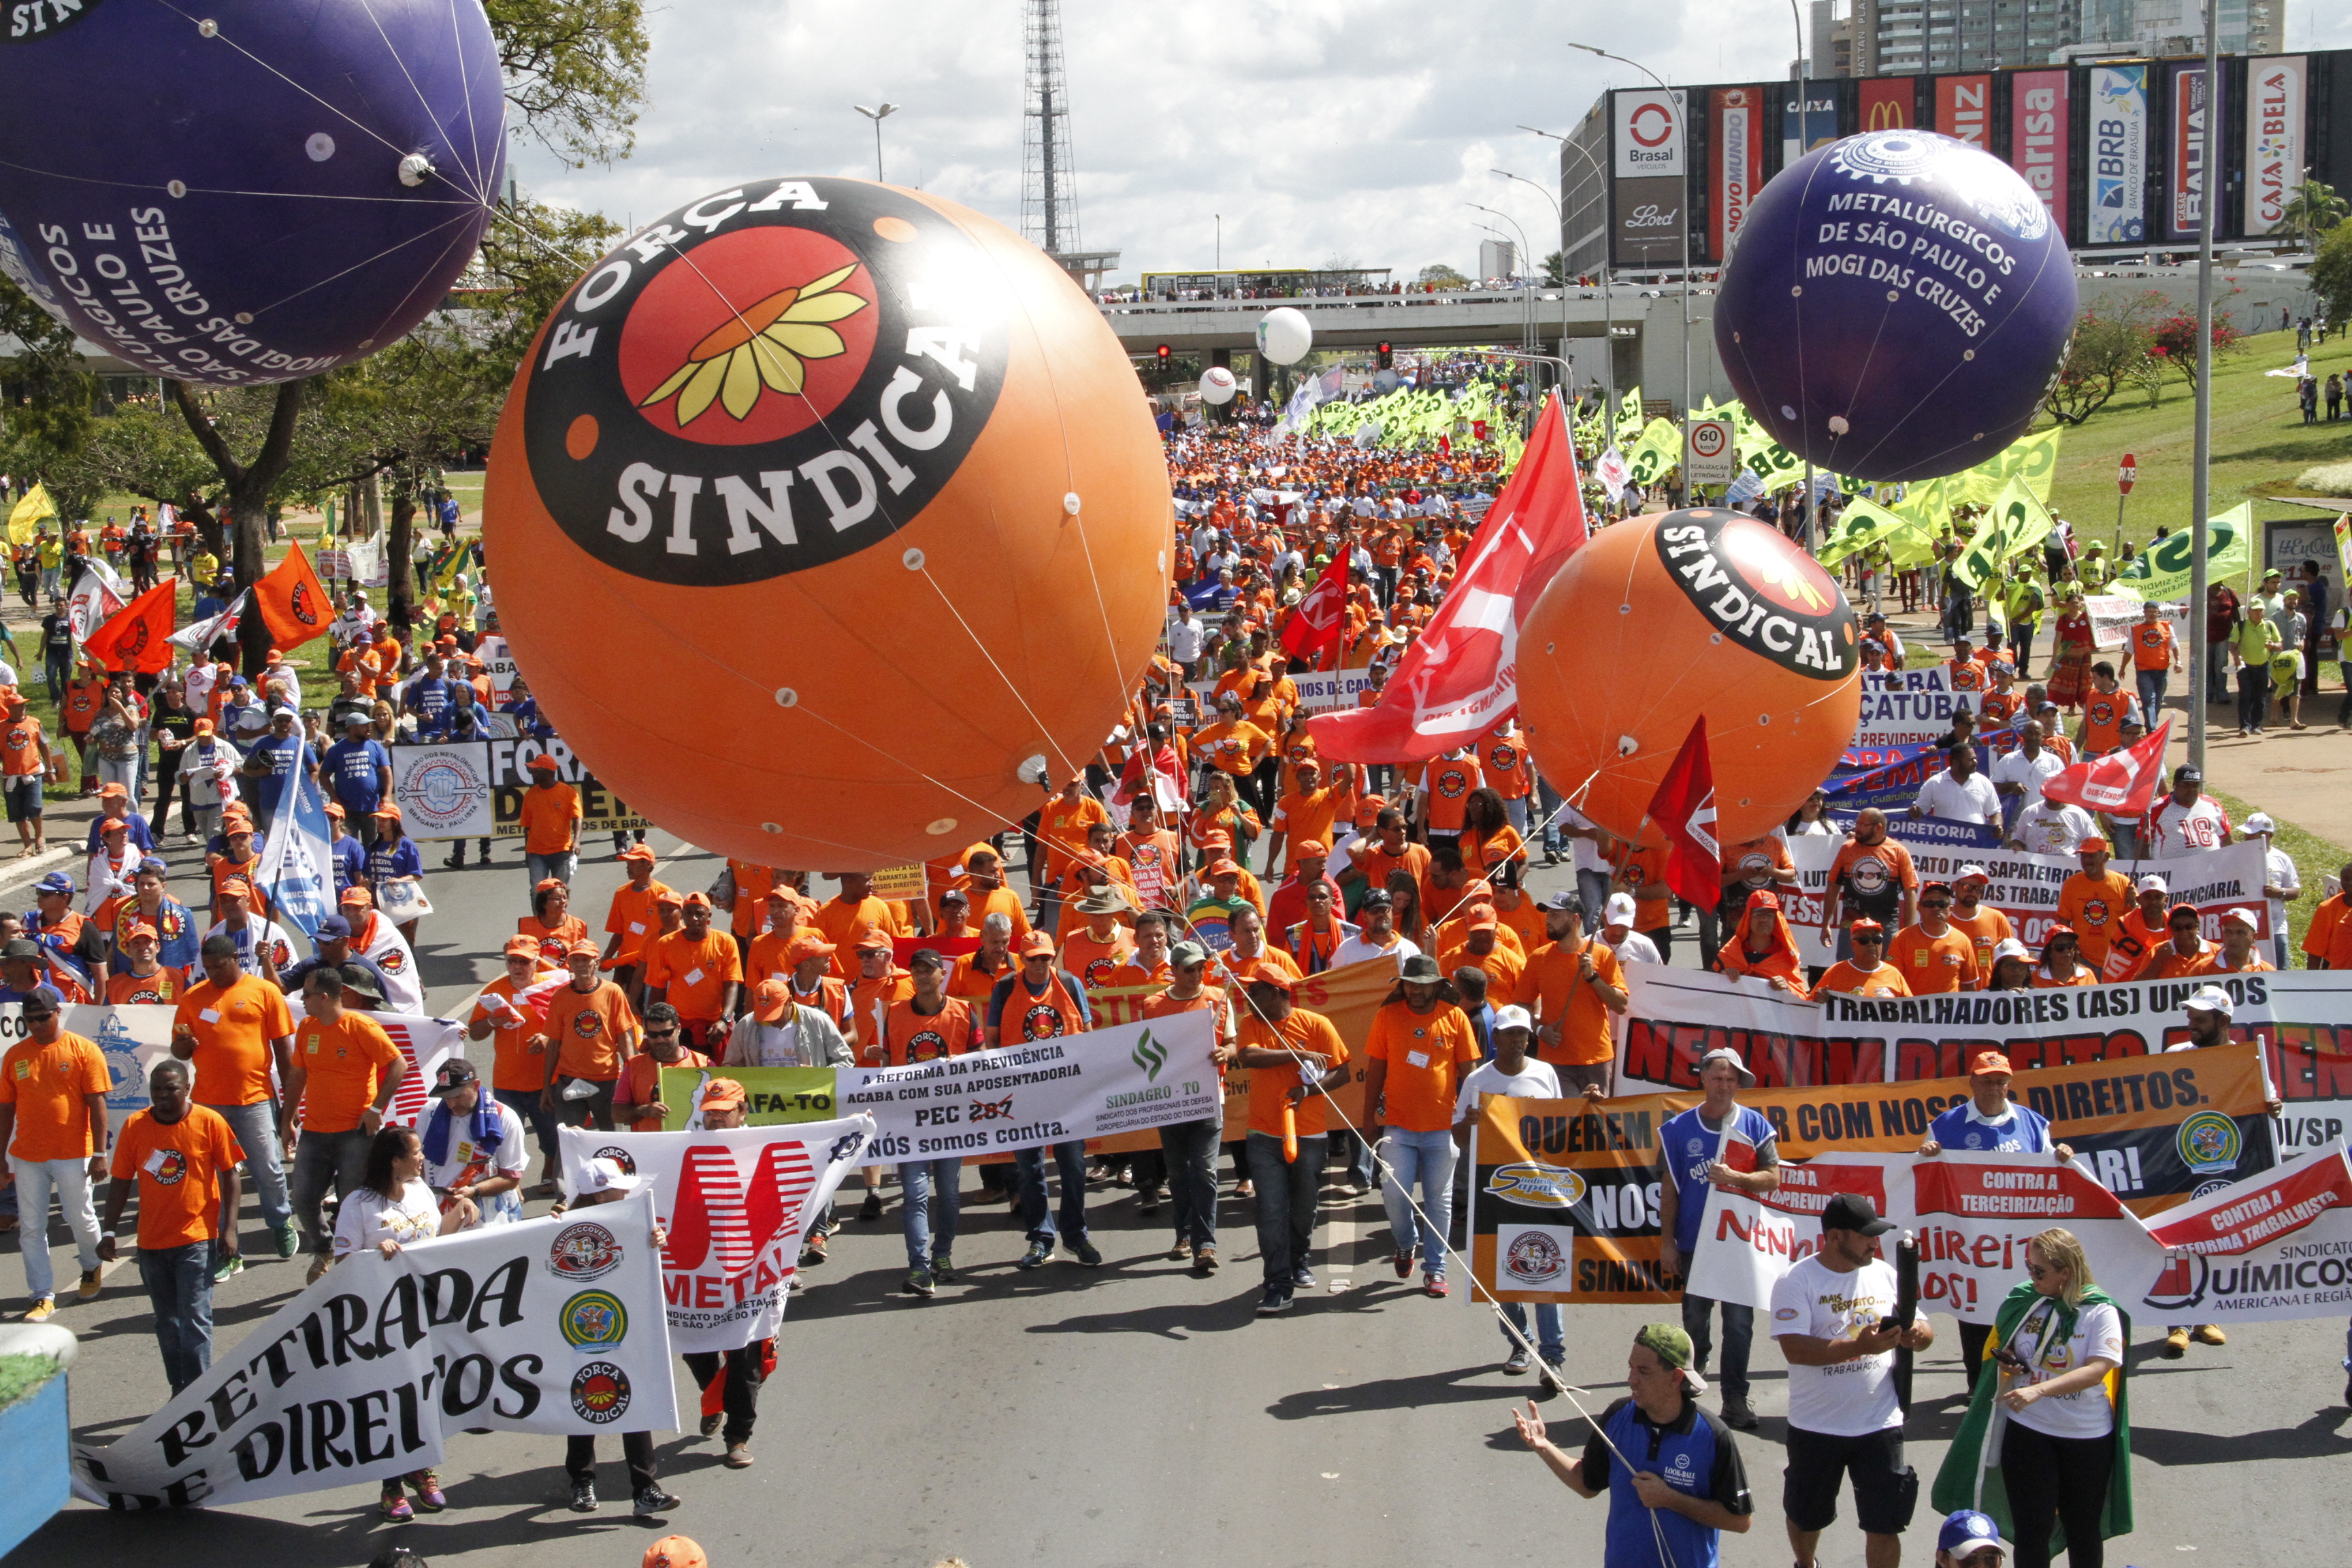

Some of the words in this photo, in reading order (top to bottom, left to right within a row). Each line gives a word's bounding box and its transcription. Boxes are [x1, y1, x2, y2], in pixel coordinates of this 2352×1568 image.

[1786, 99, 1833, 113] CAIXA
[2264, 72, 2285, 135] BELA
[2097, 119, 2125, 176] BRB
[2129, 121, 2139, 160] BRASÍLIA
[1630, 148, 1673, 162] Brasal
[2129, 163, 2138, 175] DE
[2129, 177, 2139, 209] BANCO
[2261, 161, 2283, 221] CASA
[1625, 205, 1678, 227] Lord
[2178, 192, 2187, 221] CASAS
[82, 222, 116, 241] E
[1827, 192, 2016, 276] METALÚRGICOS
[131, 207, 210, 316] CRUZES
[1818, 222, 1849, 243] DE
[1855, 221, 1906, 250] SÃO
[1910, 236, 1986, 290] PAULO
[1984, 284, 2002, 306] E
[543, 181, 830, 372] FORÇA
[95, 253, 188, 345] PAULO
[1806, 254, 1863, 278] MOGI
[1869, 258, 1915, 289] DAS
[1915, 276, 1987, 338] CRUZES
[195, 316, 263, 357] DAS
[250, 348, 342, 372] MOGI
[606, 282, 984, 556] SINDICA
[1699, 430, 1718, 442] 60
[2119, 466, 2136, 482] PARE
[1664, 525, 1842, 671] SINDICAL
[1954, 681, 1975, 691] SINDICAL
[2092, 713, 2113, 727] SINDICAL
[1493, 745, 1514, 754] FORÇA
[403, 757, 424, 786] SINDICATO
[425, 751, 438, 760] DOS
[440, 751, 480, 783] METALÚRGICOS
[1492, 757, 1516, 770] SINDICAL
[1441, 770, 1465, 780] FORÇA
[1439, 783, 1467, 798] SINDICAL
[1856, 798, 1868, 807] de
[1872, 791, 1920, 804] Guarulhos
[408, 808, 444, 830] BRAGANÇA
[449, 805, 478, 828] PAULISTA
[602, 820, 619, 830] DE
[1889, 819, 1977, 840] DIRETORIA
[2178, 817, 2213, 848] 18
[1136, 844, 1157, 852] FORÇA
[1139, 881, 1160, 889] JUROS
[2087, 900, 2106, 909] FORÇA
[2083, 913, 2108, 926] SINDICAL
[538, 937, 564, 952] FORÇA
[1089, 959, 1115, 973] FORÇA
[129, 991, 159, 1002] FORÇA
[1827, 992, 2069, 1026] TRABALHADORES
[2077, 987, 2140, 1019] (AS)
[576, 1010, 600, 1022] FORÇA
[1026, 1005, 1058, 1020] FORÇA
[574, 1023, 602, 1039] SINDICAL
[911, 1031, 942, 1051] FORÇA
[862, 1073, 872, 1085] A
[876, 1066, 945, 1083] REFORMA
[949, 1063, 968, 1075] DA
[972, 1045, 1065, 1073] PREVIDÊNCIA
[847, 1091, 894, 1104] ACABA
[898, 1086, 929, 1100] COM
[934, 1083, 963, 1097] SUA
[966, 1064, 1081, 1093] APOSENTADORIA
[1106, 1085, 1172, 1109] SINDAGRO
[1182, 1081, 1200, 1096] TO
[915, 1105, 960, 1127] PEC
[1095, 1109, 1125, 1122] SINDICATO
[1126, 1108, 1138, 1116] DOS
[1139, 1100, 1181, 1113] PROFISSIONAIS
[1191, 1096, 1213, 1105] DEFESA
[1096, 1119, 1141, 1132] AGROPECUÁRIA
[1150, 1113, 1173, 1123] ESTADO
[1183, 1106, 1214, 1117] TOCANTINS
[1520, 1110, 1653, 1157] QUEREM
[1797, 1101, 1874, 1142] COM
[2027, 1068, 2210, 1122] DIREITOS.
[868, 1132, 911, 1158] NÓS
[919, 1131, 988, 1153] somos
[995, 1120, 1069, 1146] contra.
[598, 1147, 630, 1162] FORÇA
[1982, 1171, 2041, 1190] CONTRA
[2048, 1171, 2057, 1190] A
[1961, 1194, 2074, 1218] TERCEIRIZAÇÃO
[2210, 1196, 2272, 1231] CONTRA
[2270, 1190, 2283, 1206] A
[2242, 1191, 2339, 1245] TRABALHISTA
[555, 1226, 610, 1251] FETINCCCOVEST
[1512, 1234, 1557, 1254] FETINCCCOVEST
[663, 1247, 796, 1309] METAL
[1819, 1294, 1844, 1305] MAIS
[2214, 1294, 2302, 1311] AMERICANA
[2304, 1294, 2310, 1304] E
[681, 1320, 704, 1329] SÃO
[735, 1311, 749, 1320] DO
[154, 1256, 530, 1469] RETIRADA
[1823, 1360, 1883, 1377] TRABALHADOR!
[576, 1364, 620, 1384] FORÇA
[229, 1353, 544, 1482] DIREITOS
[574, 1394, 630, 1423] SINDICAL
[1665, 1467, 1696, 1479] LOOK-BALL
